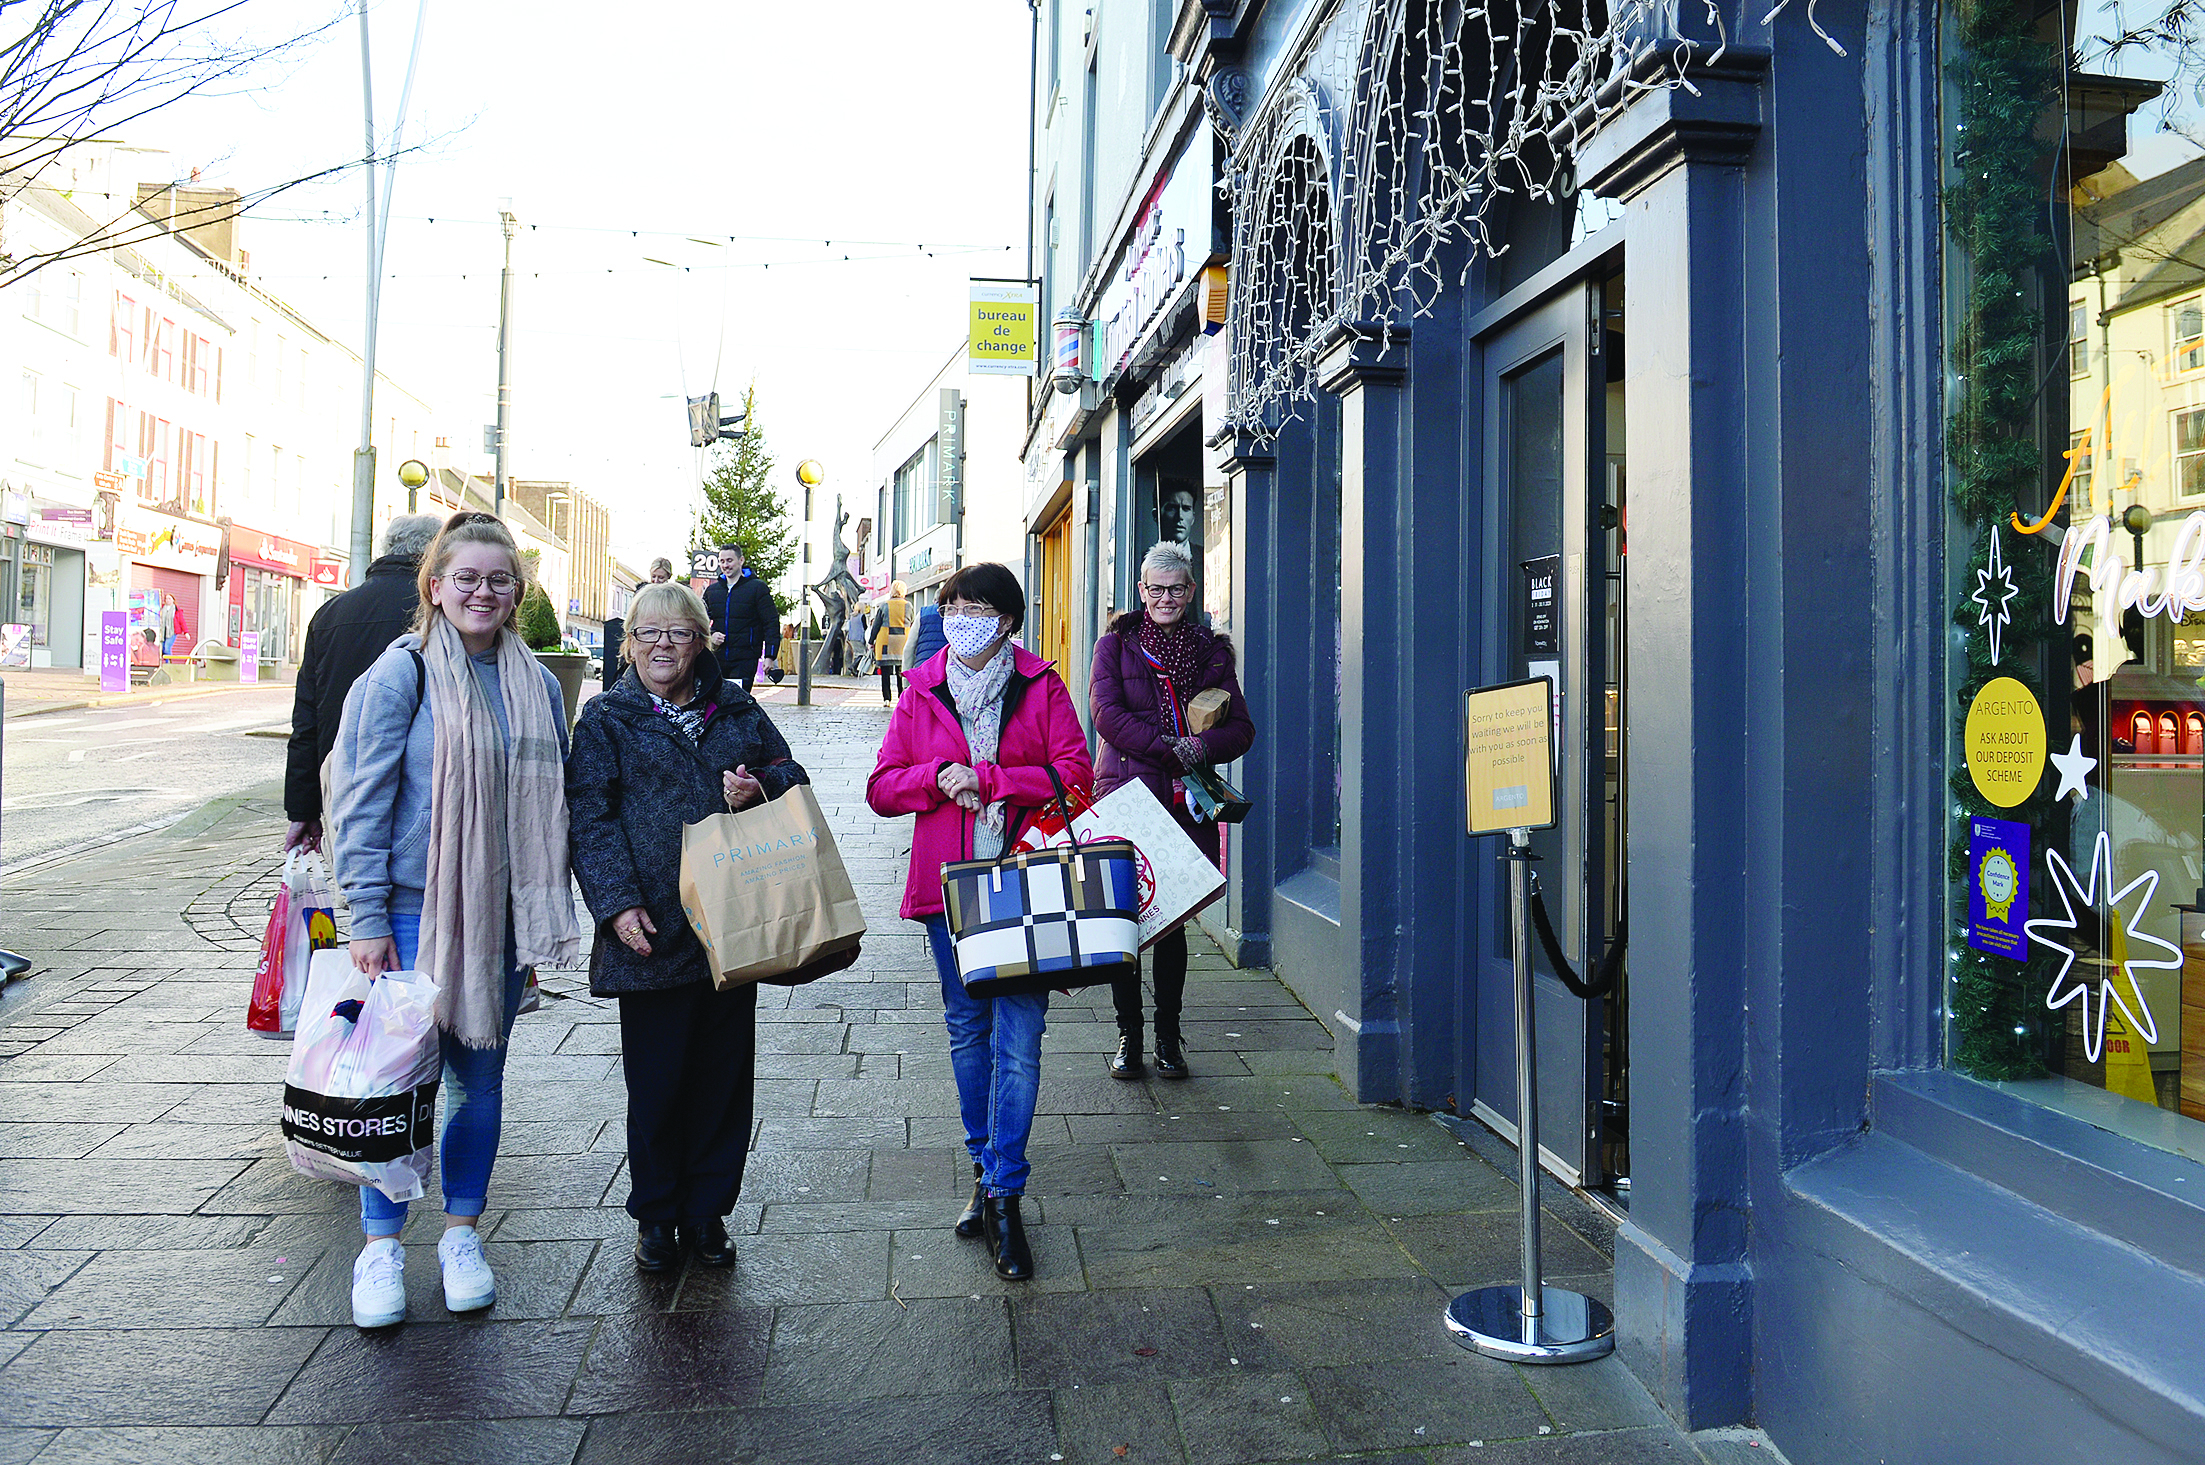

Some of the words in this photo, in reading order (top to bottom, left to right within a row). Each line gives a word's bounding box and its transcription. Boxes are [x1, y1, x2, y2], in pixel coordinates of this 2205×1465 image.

[978, 308, 1026, 321] bureau
[993, 325, 1010, 336] de
[977, 340, 1026, 354] change
[942, 410, 957, 501] PRIMARK
[30, 520, 50, 535] Print
[693, 554, 719, 572] 20
[1531, 576, 1552, 590] BLACK
[104, 625, 124, 636] Stay
[104, 636, 124, 646] Safe
[1472, 713, 1493, 724] Sorry
[1495, 712, 1504, 720] to
[1505, 708, 1526, 717] keep
[1527, 704, 1543, 714] you
[1976, 700, 2034, 716] ARGENTO
[1472, 727, 1501, 738] waiting
[1502, 725, 1515, 734] we
[1516, 721, 1532, 730] will
[1534, 719, 1545, 728] be
[1469, 744, 1487, 754] with
[1488, 742, 1504, 752] you
[1506, 740, 1514, 748] as
[1516, 737, 1537, 746] soon
[1538, 735, 1548, 744] as
[1980, 732, 1997, 744] ASK
[1998, 732, 2029, 744] ABOUT
[1492, 754, 1525, 768] possible
[1976, 750, 1994, 762] OUR
[1996, 752, 2034, 764] DEPOSIT
[1986, 770, 2022, 782] SCHEME
[1496, 792, 1524, 802] ARGENTO
[714, 827, 819, 868] PRIMARK
[740, 863, 772, 877] AMAZING
[745, 871, 777, 885] AMAZING
[780, 862, 806, 874] PRICES
[1986, 870, 2010, 881] Confidence
[322, 1114, 407, 1138] STORES
